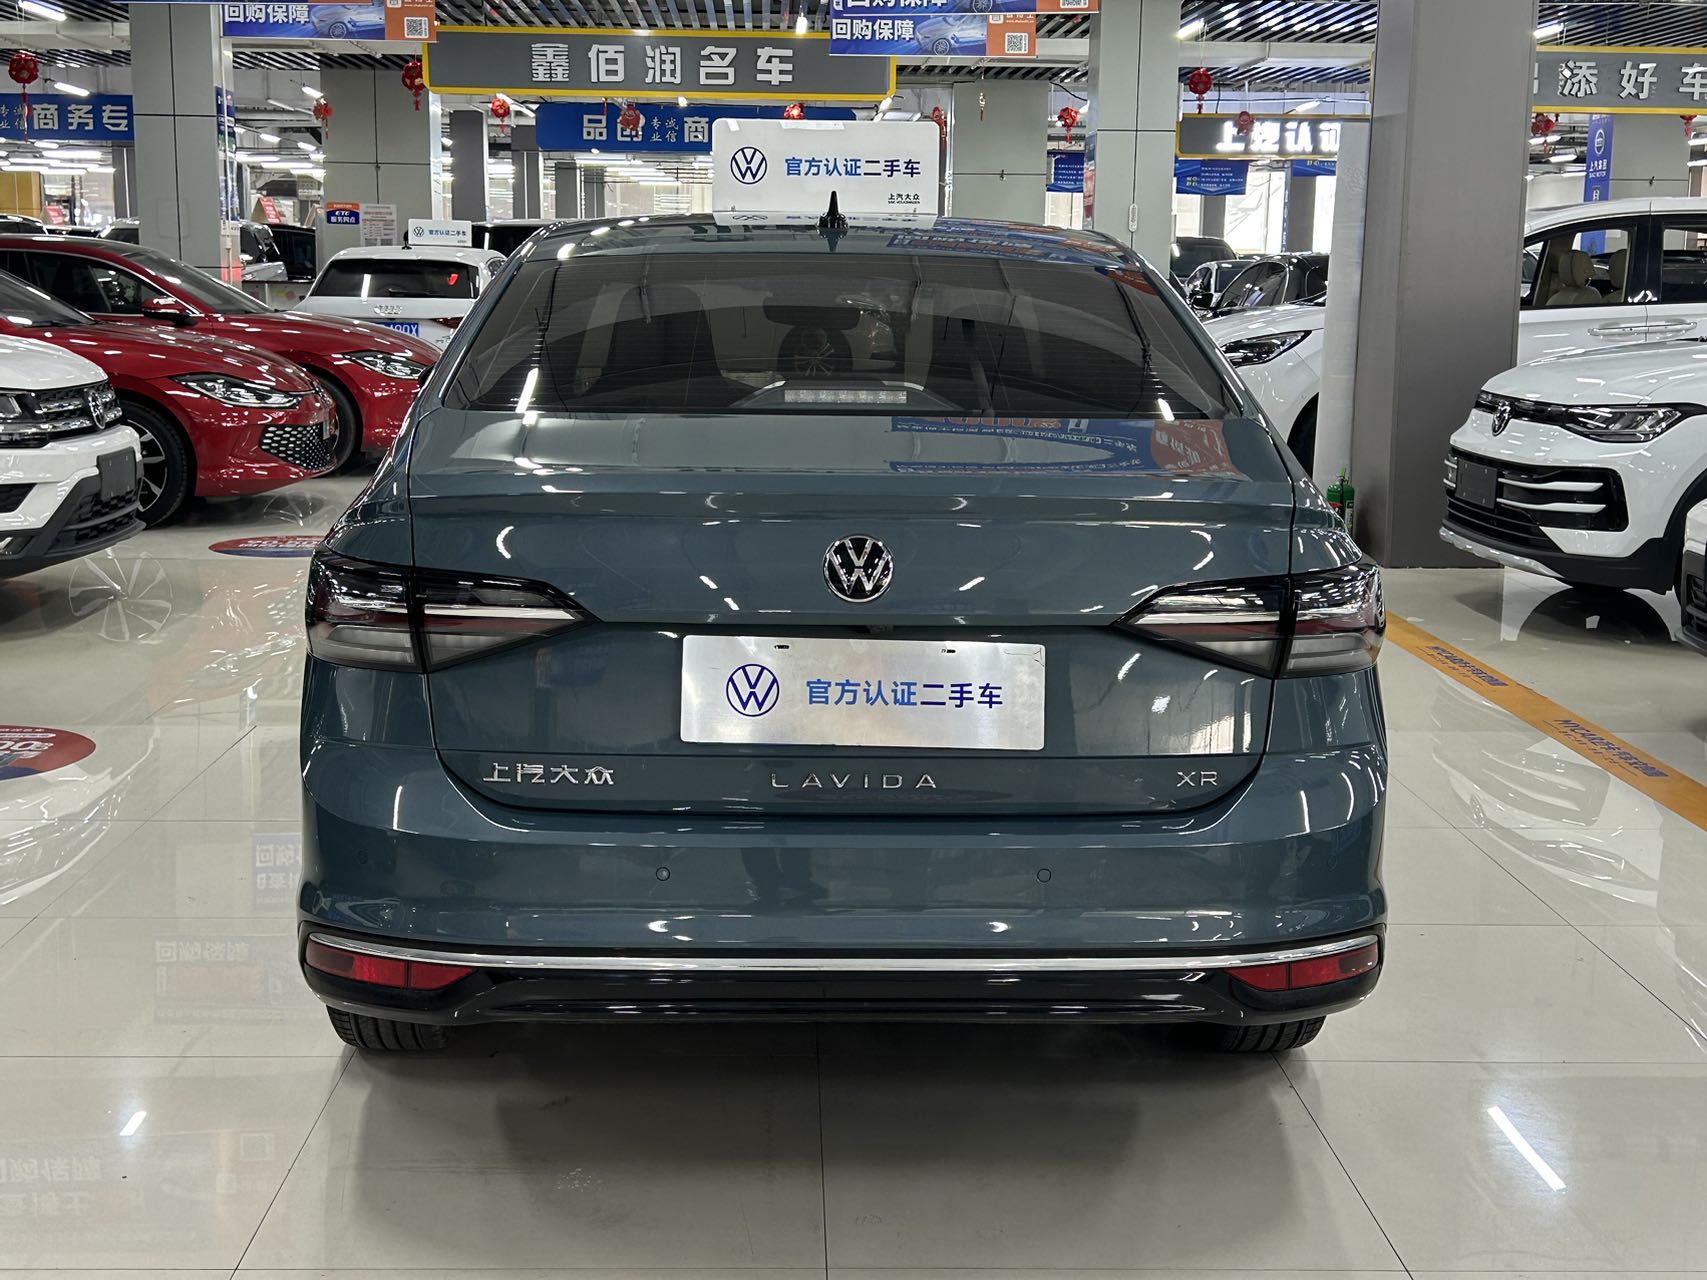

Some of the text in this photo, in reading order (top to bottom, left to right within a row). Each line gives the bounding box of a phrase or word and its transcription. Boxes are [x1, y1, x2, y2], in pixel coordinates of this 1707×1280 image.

[224, 4, 310, 24] 回购保障
[832, 19, 914, 40] 回购保障
[530, 42, 794, 87] 鑫佰润名车
[1533, 60, 1707, 101] 添好车
[785, 157, 921, 178] 官方认证二手车
[806, 679, 1004, 709] 官方认证二手车
[483, 762, 614, 785] 上汽大众
[771, 773, 937, 789] LAVIDA
[1176, 771, 1218, 788] XR
